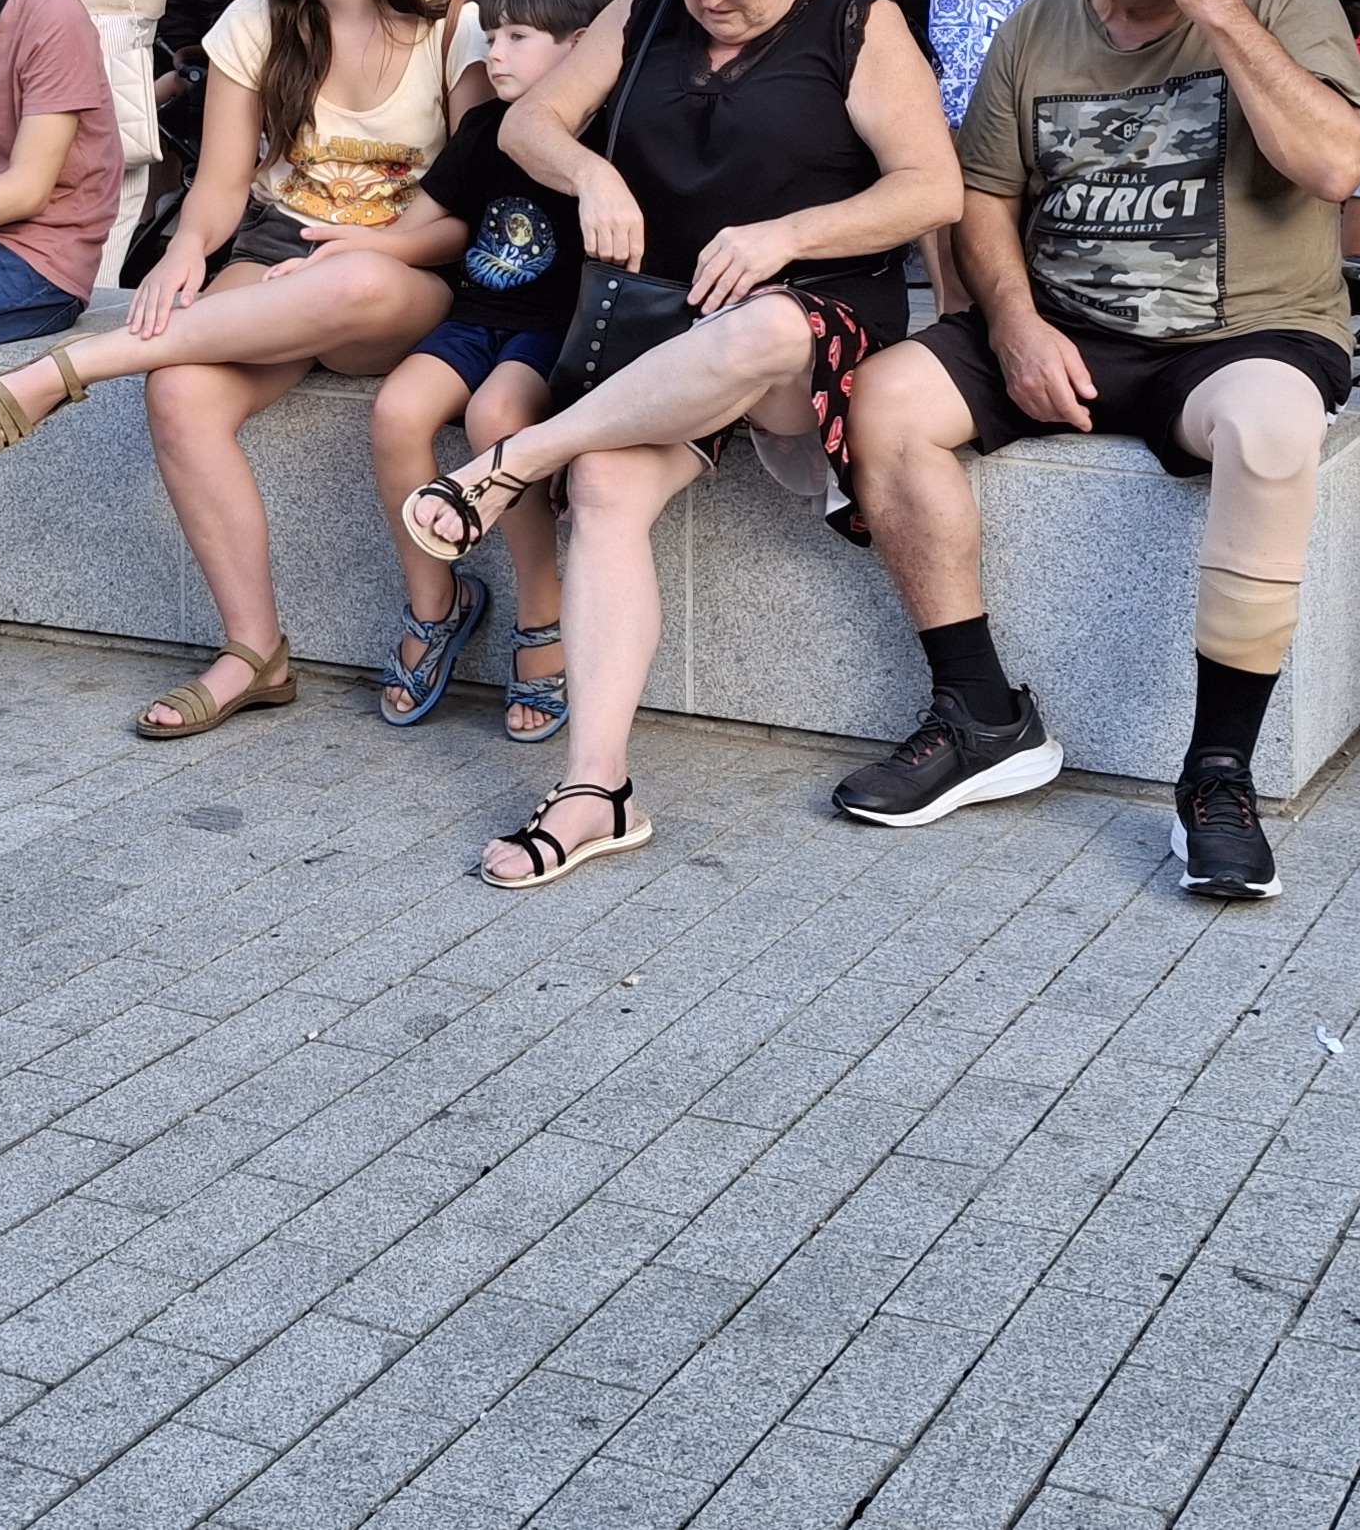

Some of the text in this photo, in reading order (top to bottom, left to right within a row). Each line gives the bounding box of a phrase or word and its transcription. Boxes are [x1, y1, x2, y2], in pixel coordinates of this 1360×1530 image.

[1123, 122, 1139, 139] 85
[1084, 172, 1149, 185] CENTRAL
[1107, 222, 1164, 233] SOCIETY
